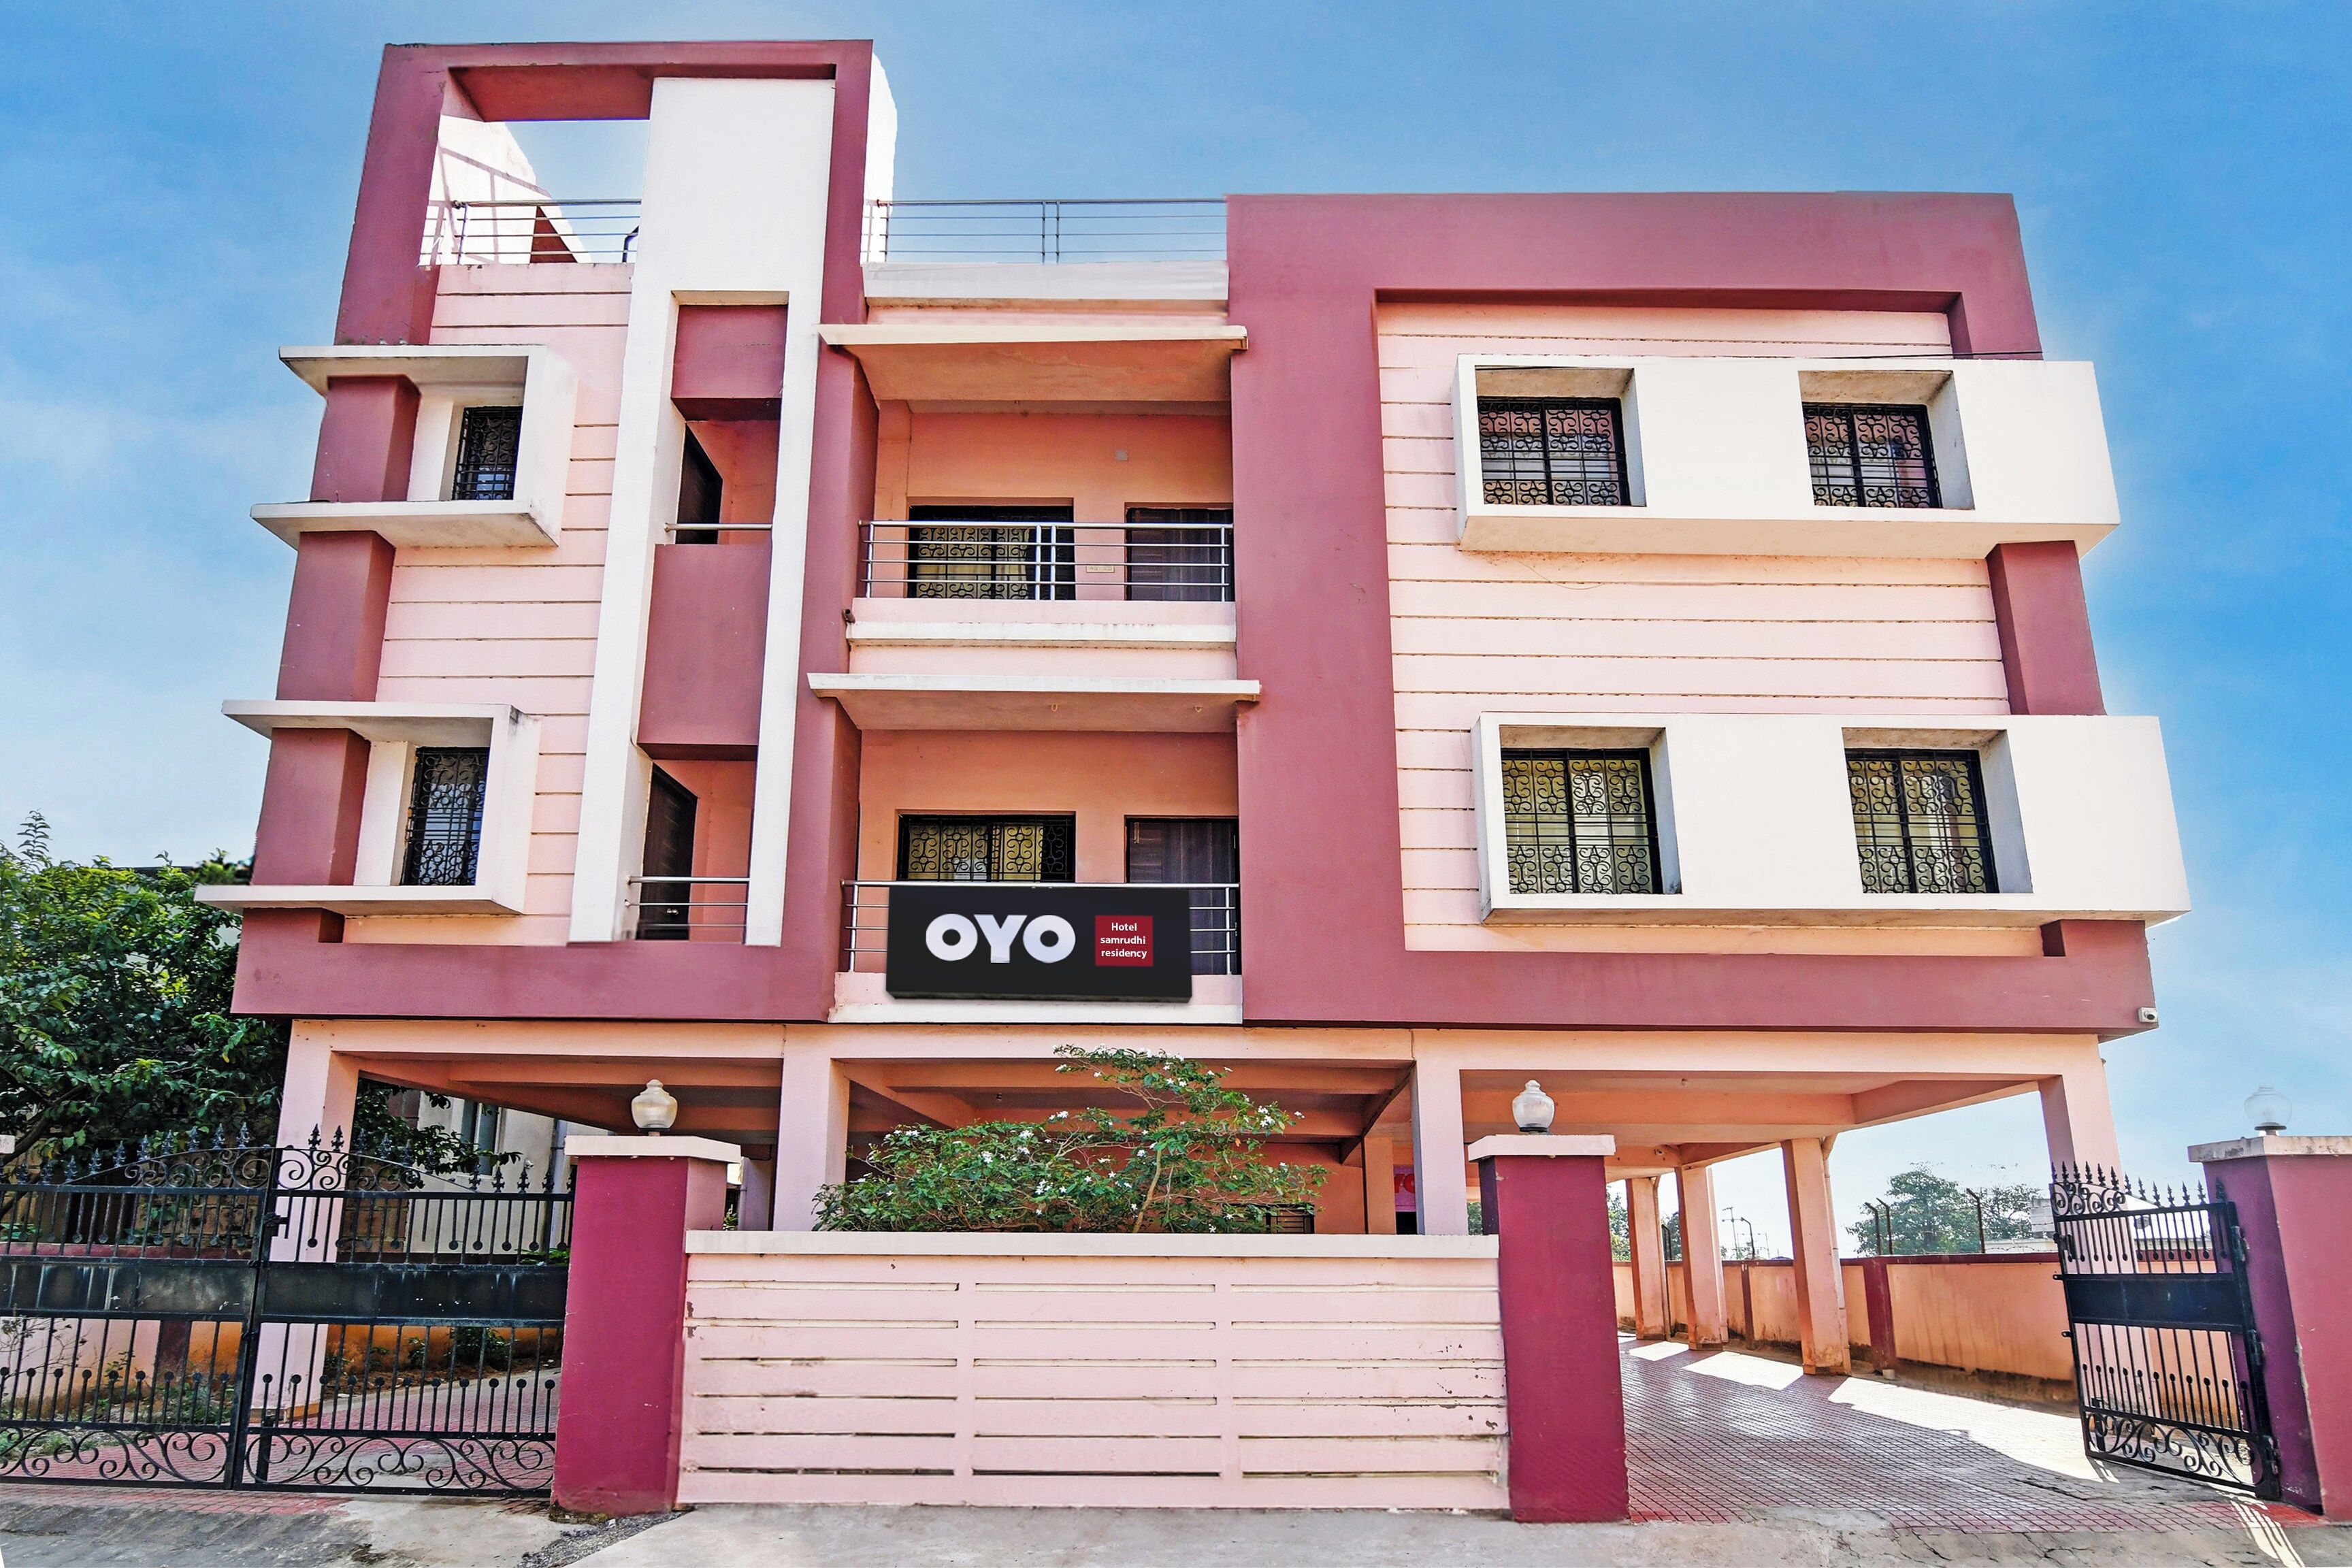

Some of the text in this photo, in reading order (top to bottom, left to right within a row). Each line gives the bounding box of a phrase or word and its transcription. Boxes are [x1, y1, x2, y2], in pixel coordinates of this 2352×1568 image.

[1111, 922, 1137, 931] Hotel
[926, 913, 1076, 964] OYO
[1100, 936, 1146, 945] samrudhi
[1101, 948, 1147, 959] residency
